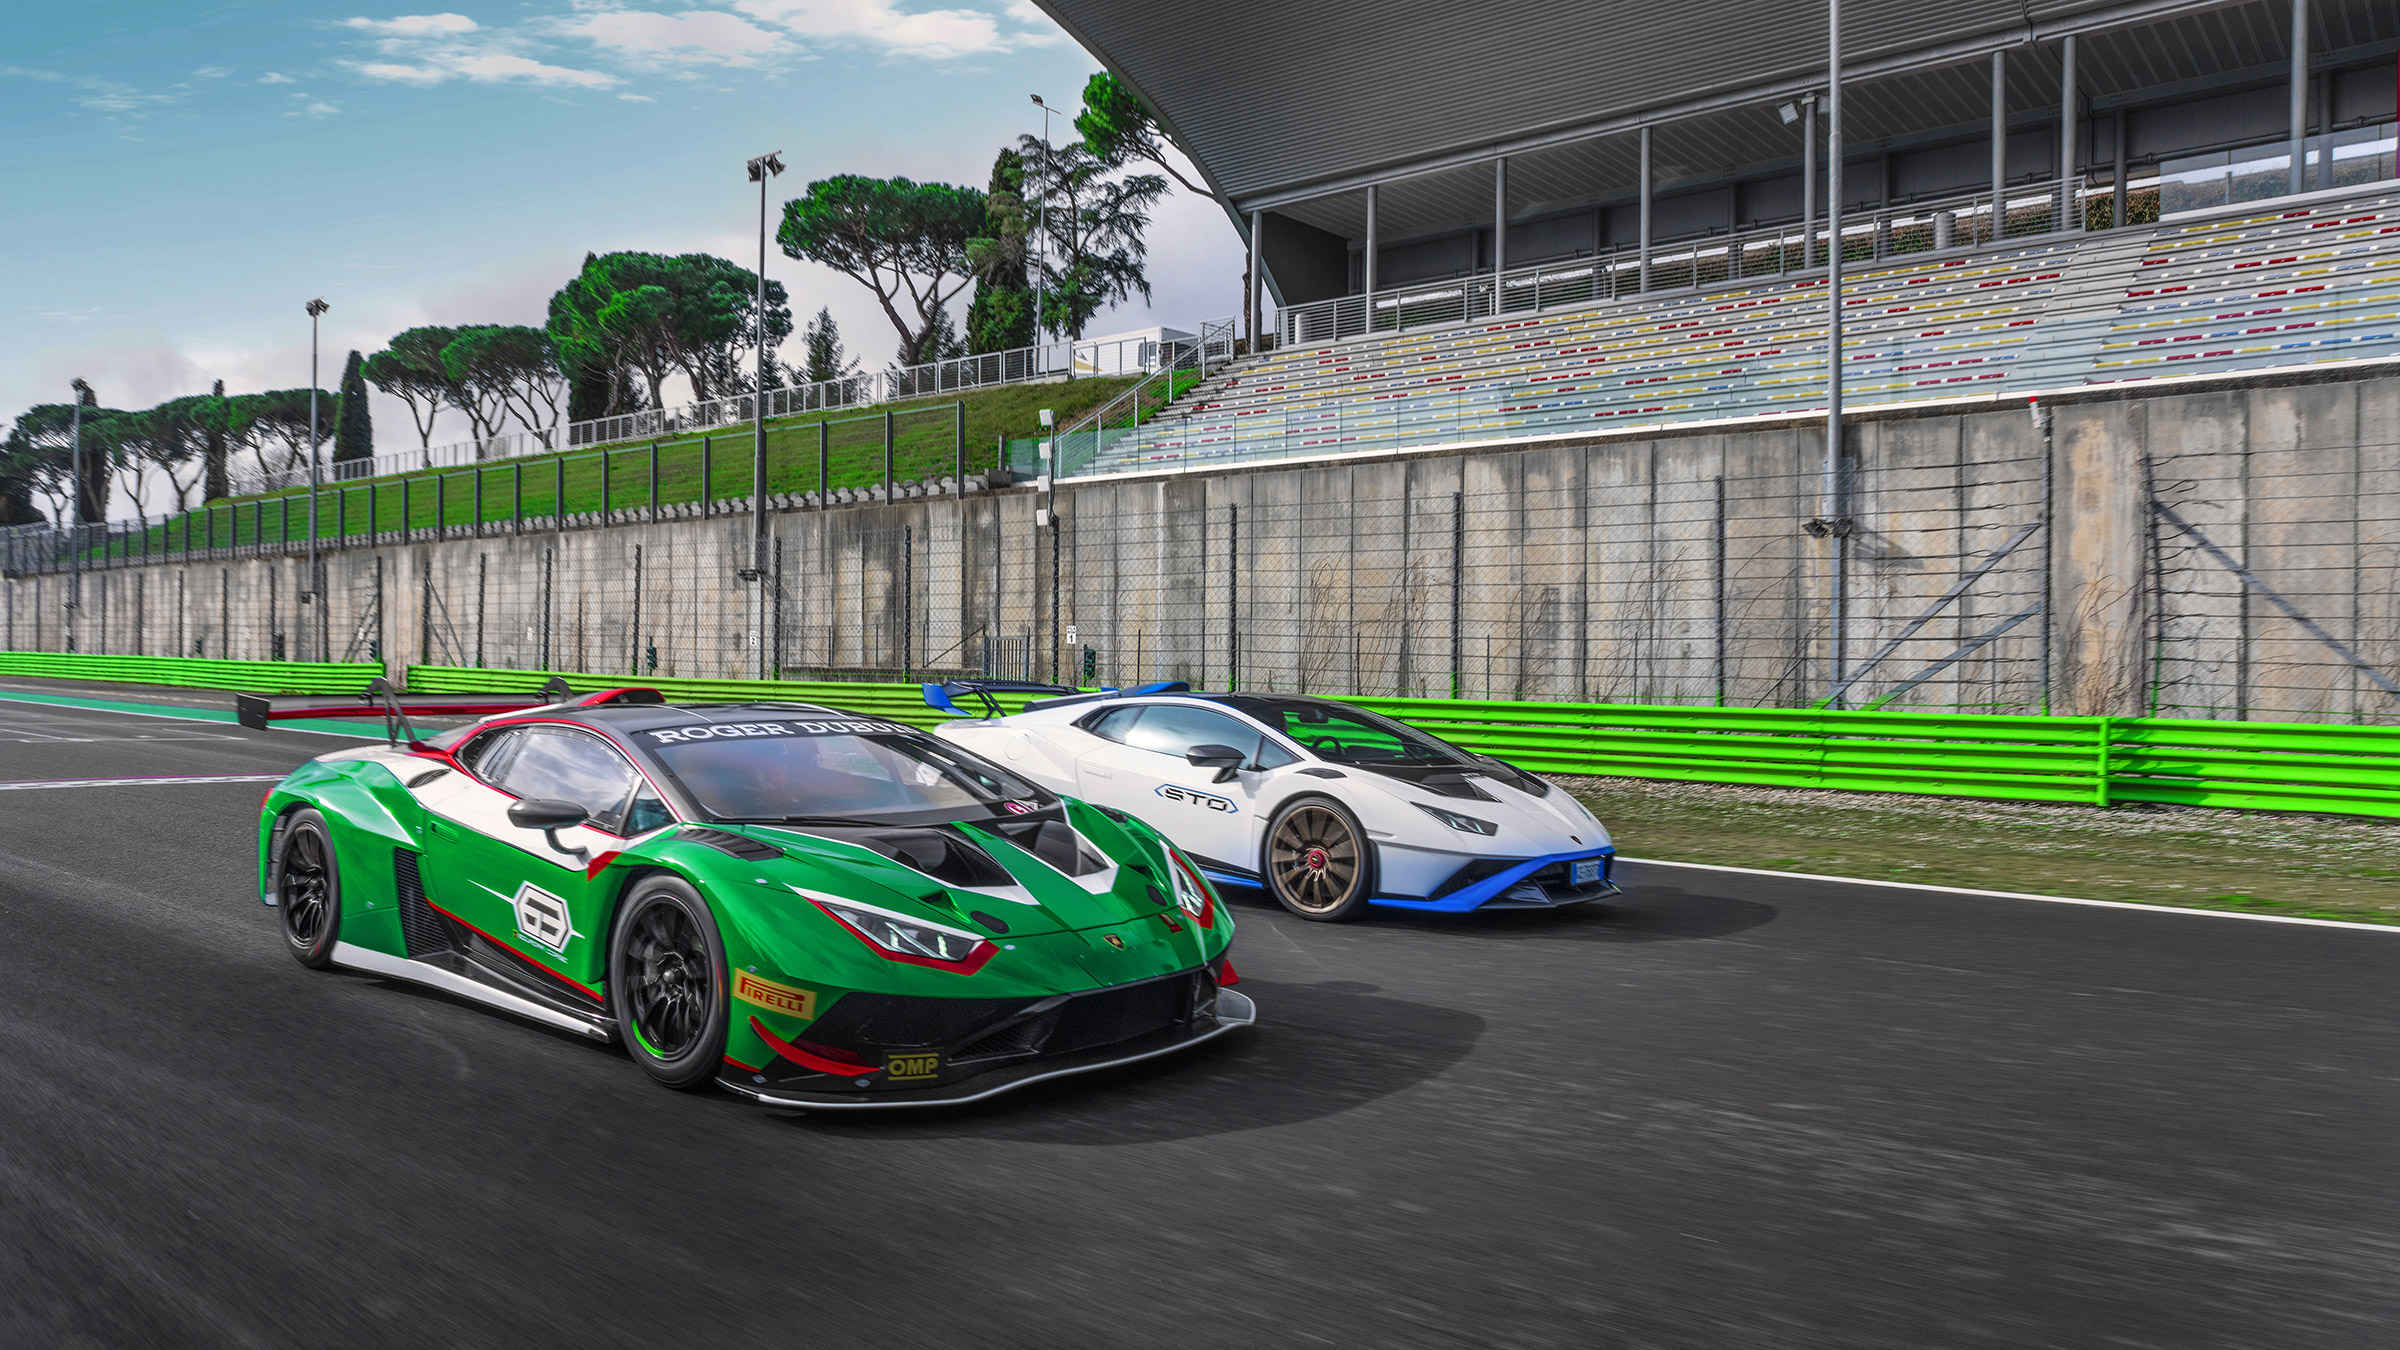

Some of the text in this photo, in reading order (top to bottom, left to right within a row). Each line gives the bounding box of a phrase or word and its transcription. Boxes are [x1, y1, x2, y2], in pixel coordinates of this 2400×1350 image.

[649, 721, 794, 744] ROGER
[1165, 787, 1228, 812] STO
[739, 976, 805, 1013] PIRELLI
[888, 1057, 939, 1076] OMP
